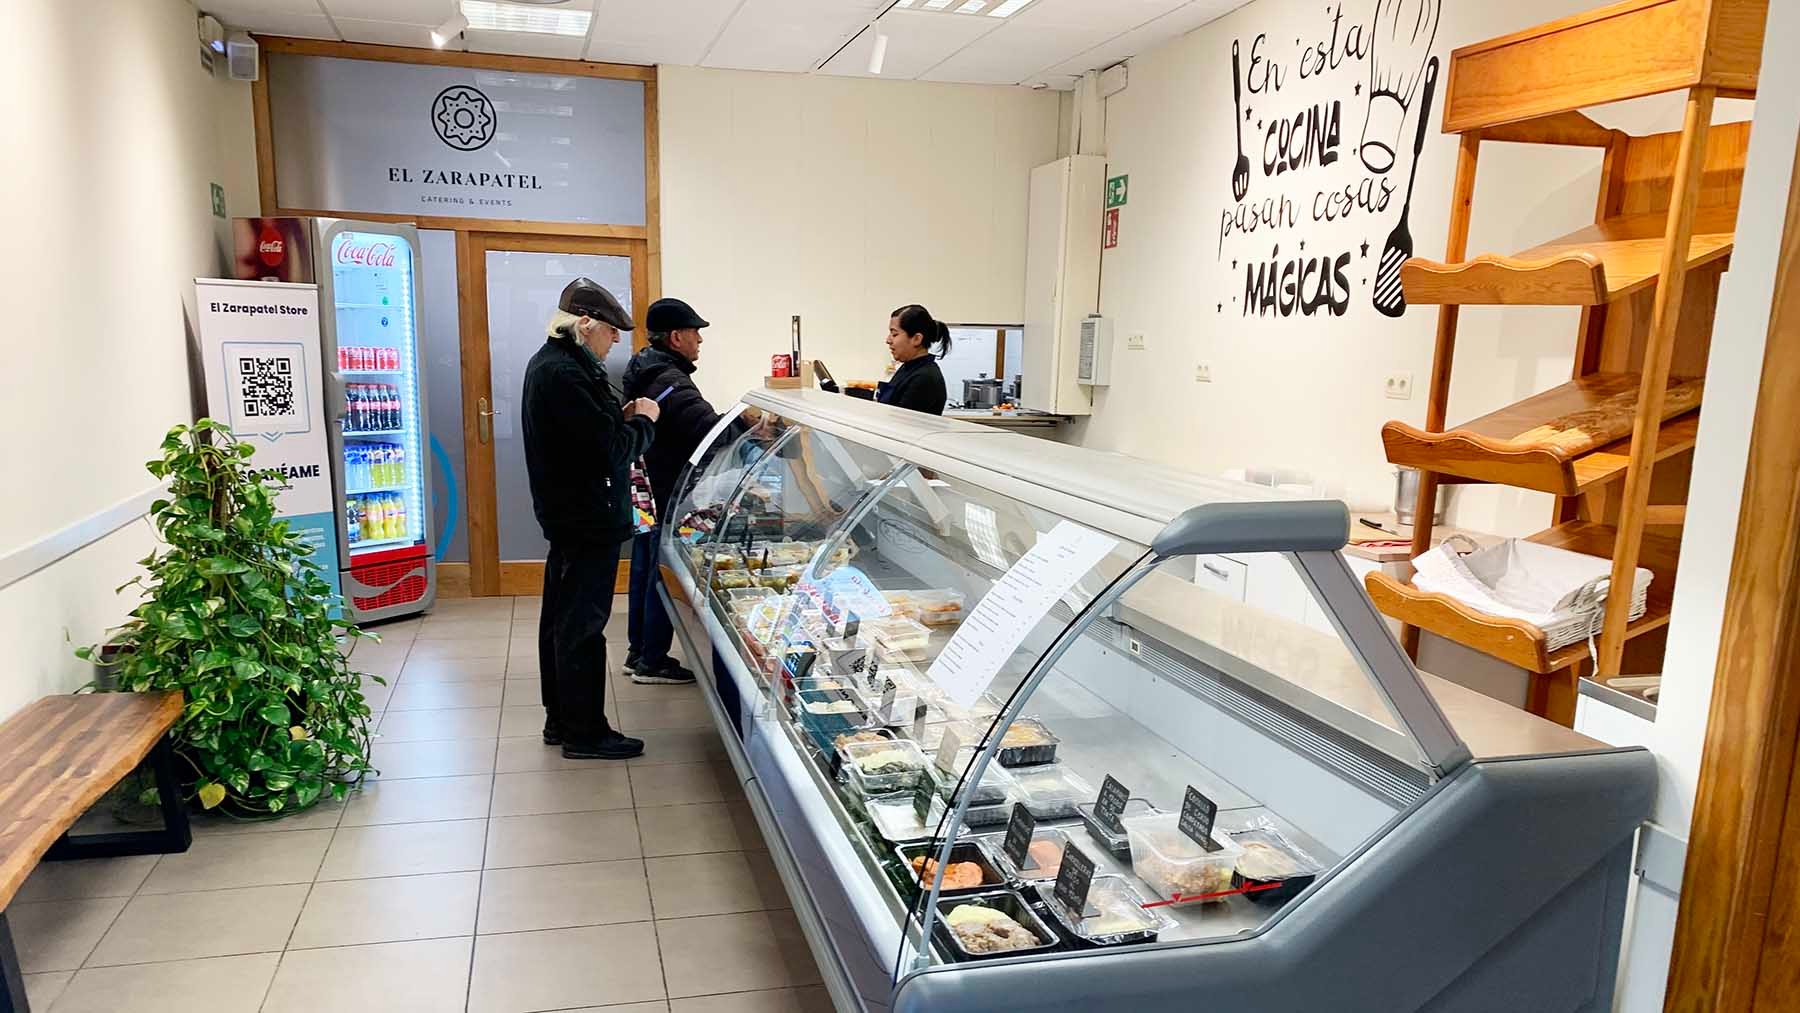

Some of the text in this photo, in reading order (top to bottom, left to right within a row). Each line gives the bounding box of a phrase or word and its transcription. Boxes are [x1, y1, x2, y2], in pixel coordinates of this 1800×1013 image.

[1248, 2, 1371, 93] En esta
[1264, 100, 1341, 176] COCINA
[389, 168, 542, 190] EL ZARAPATEL
[421, 196, 464, 204] CATERING
[479, 199, 513, 207] EVENTS
[1218, 177, 1397, 262] pasan cosas
[210, 302, 308, 316] El Zarapatel Store
[1243, 243, 1351, 317] MÁGICAS
